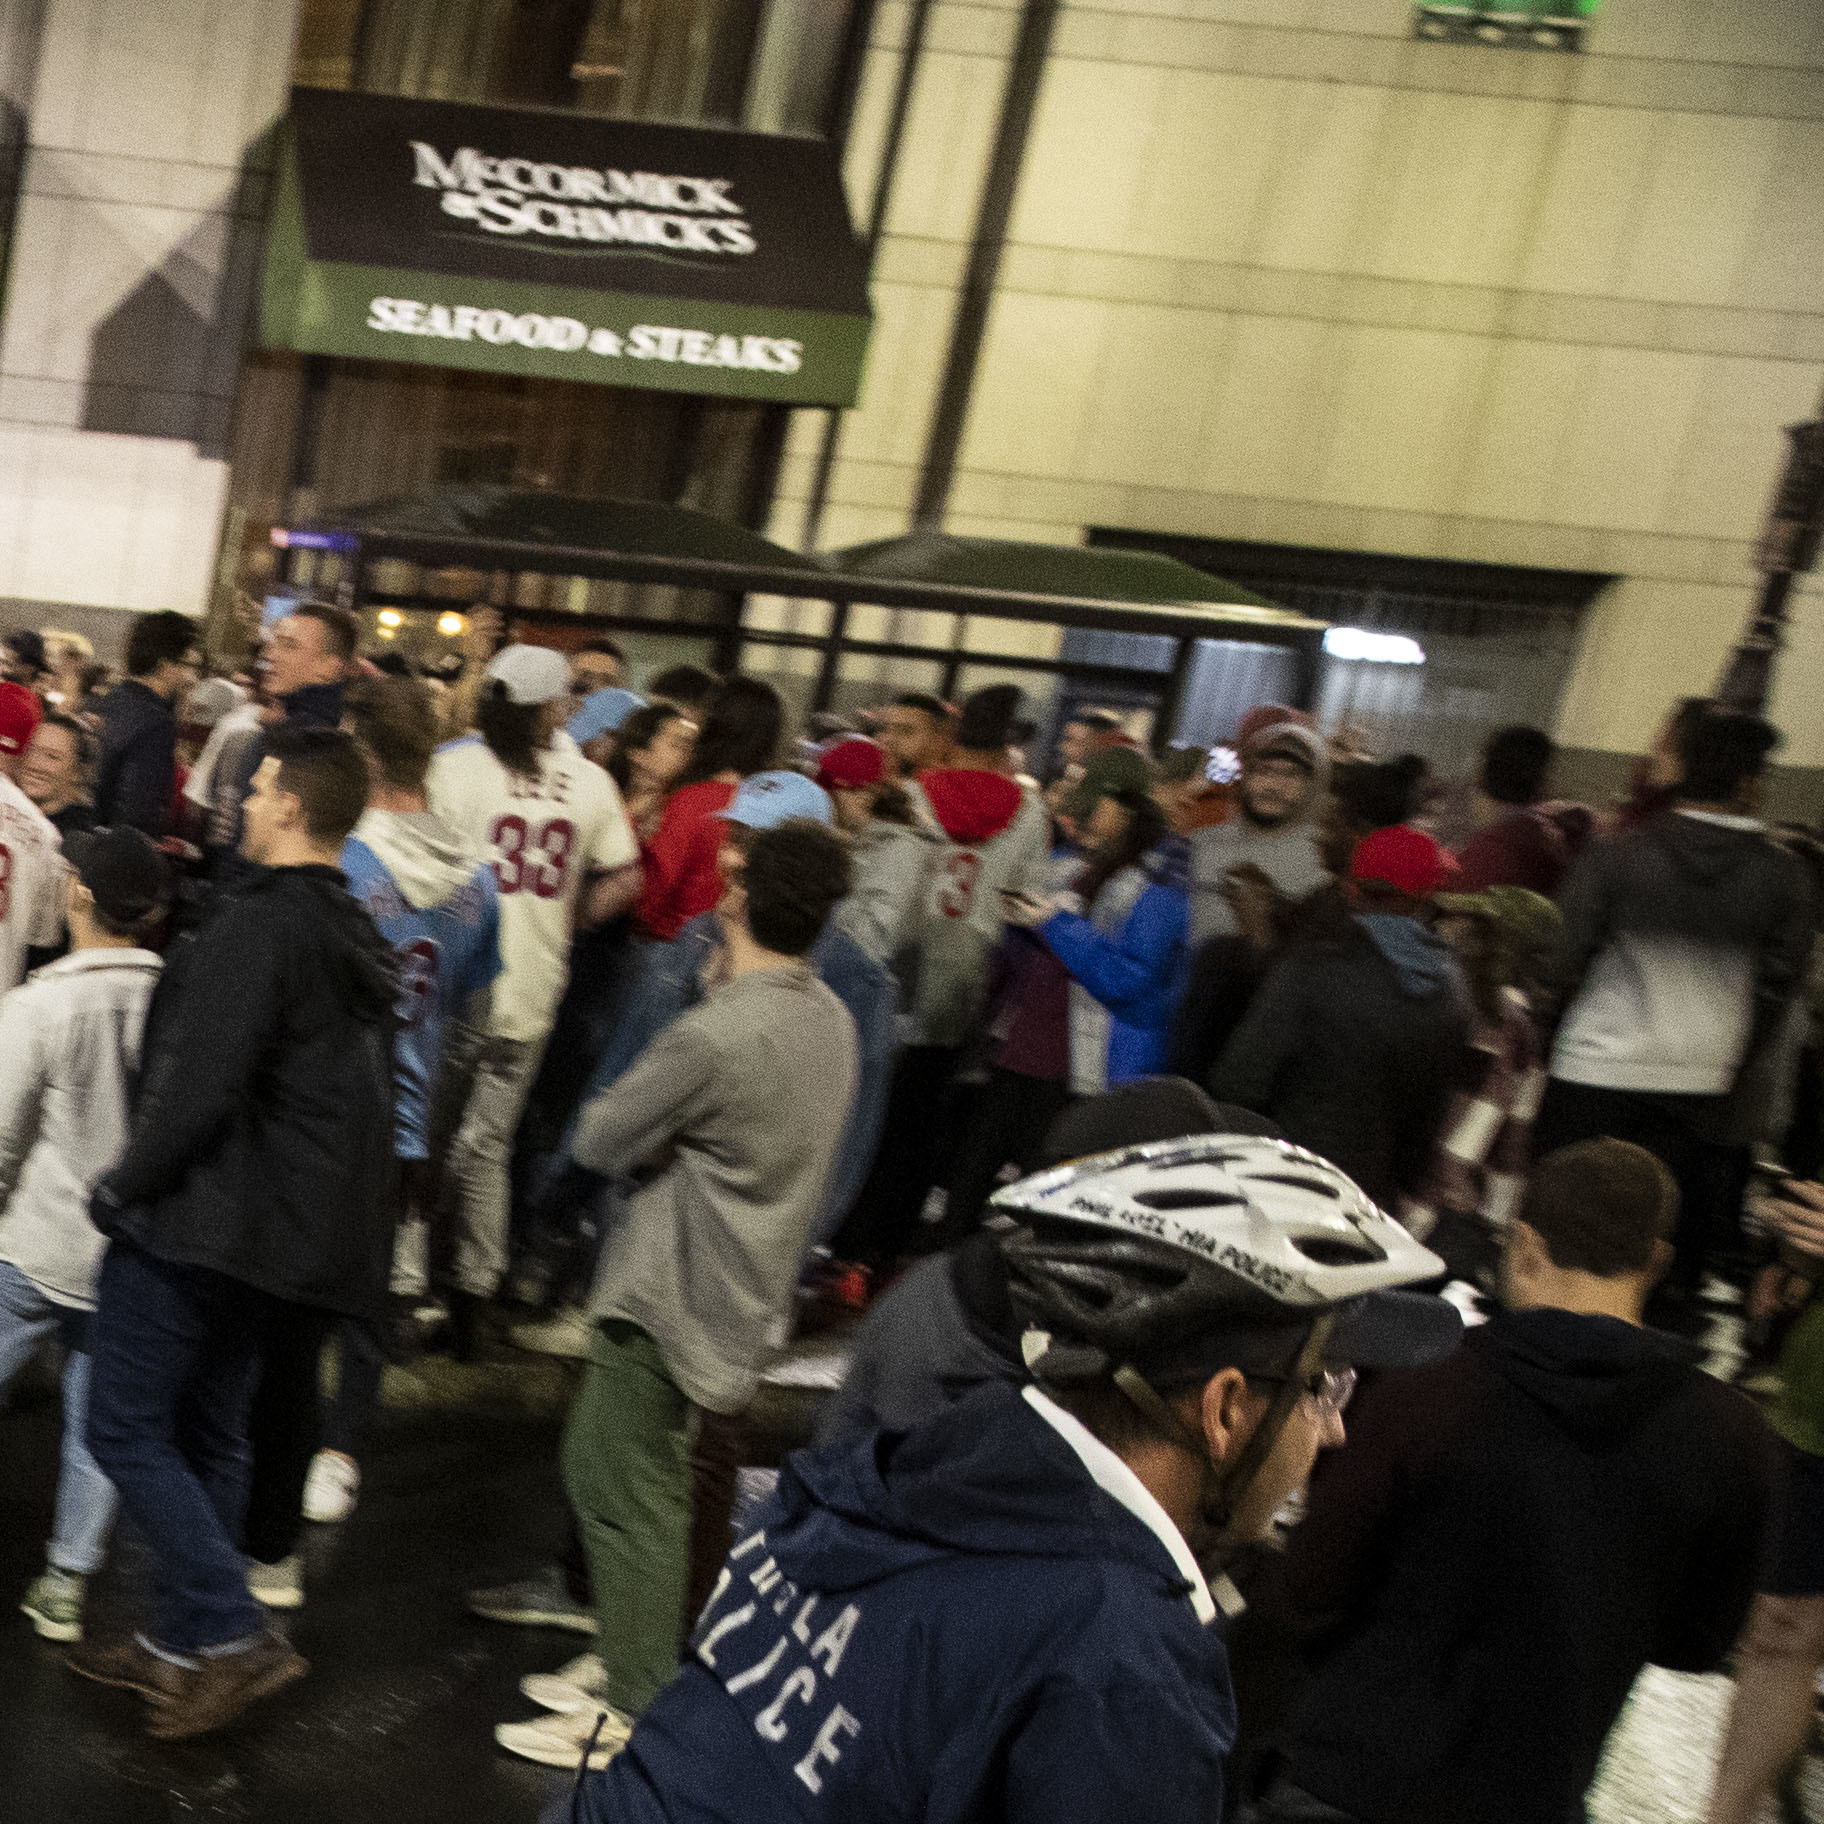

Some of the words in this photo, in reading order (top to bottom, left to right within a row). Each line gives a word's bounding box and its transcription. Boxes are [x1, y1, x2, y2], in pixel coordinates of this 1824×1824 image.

[367, 297, 587, 352] SEAFOOD
[588, 327, 622, 358] &
[626, 323, 804, 375] STEAKS
[490, 814, 574, 899] 33
